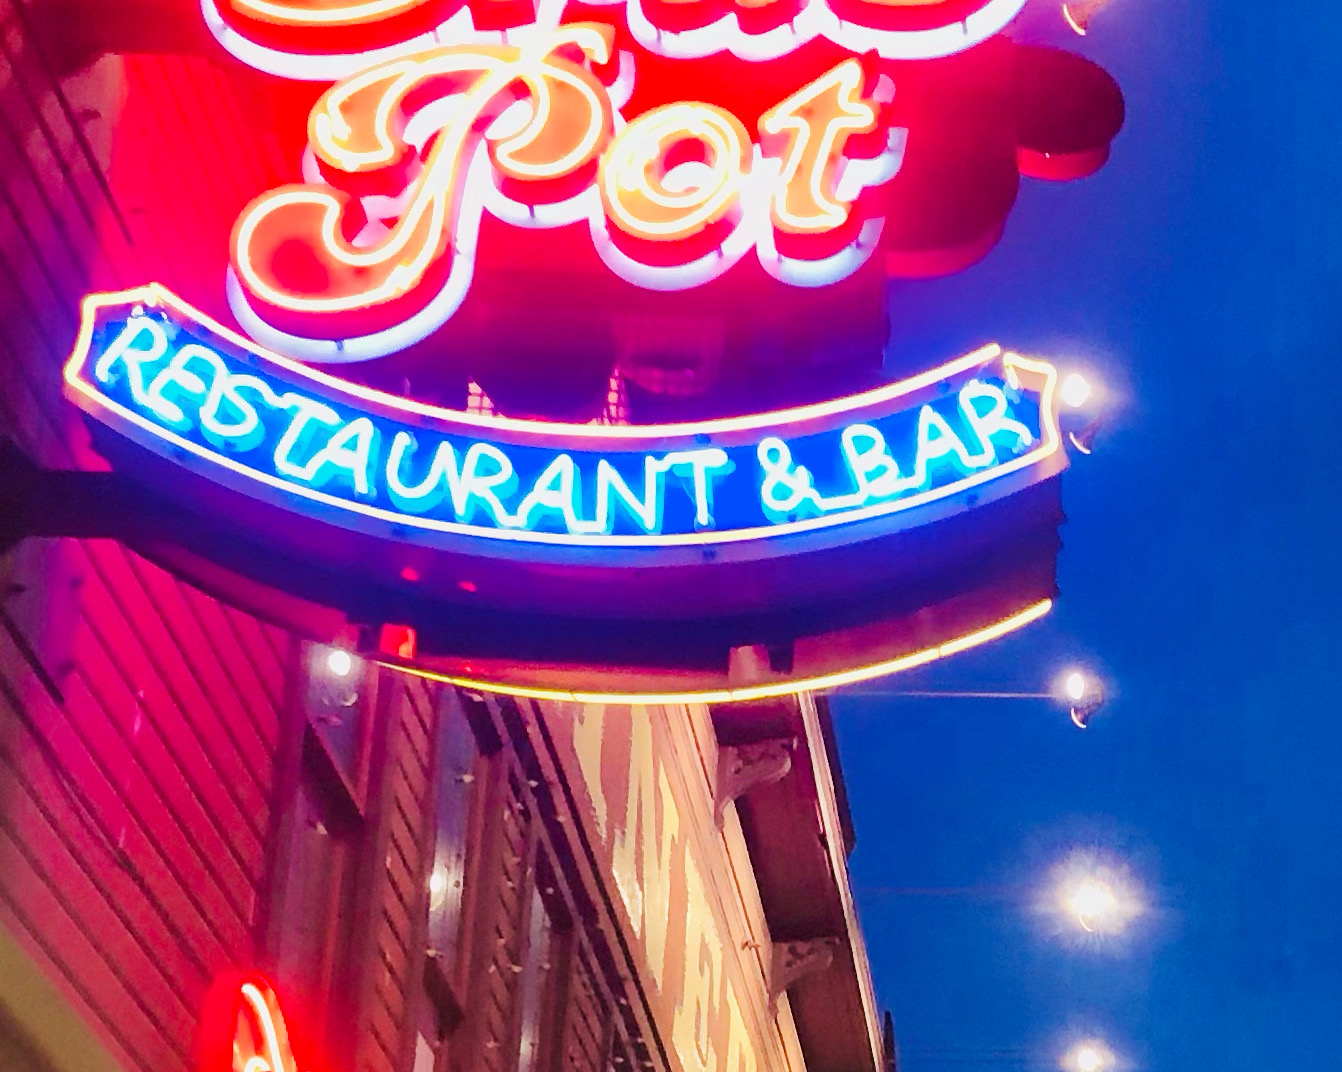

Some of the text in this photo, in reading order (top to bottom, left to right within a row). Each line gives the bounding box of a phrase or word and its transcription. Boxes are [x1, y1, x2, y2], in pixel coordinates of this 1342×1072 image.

[226, 20, 905, 362] Pot
[97, 316, 1035, 535] RESTAURANT & BAR
